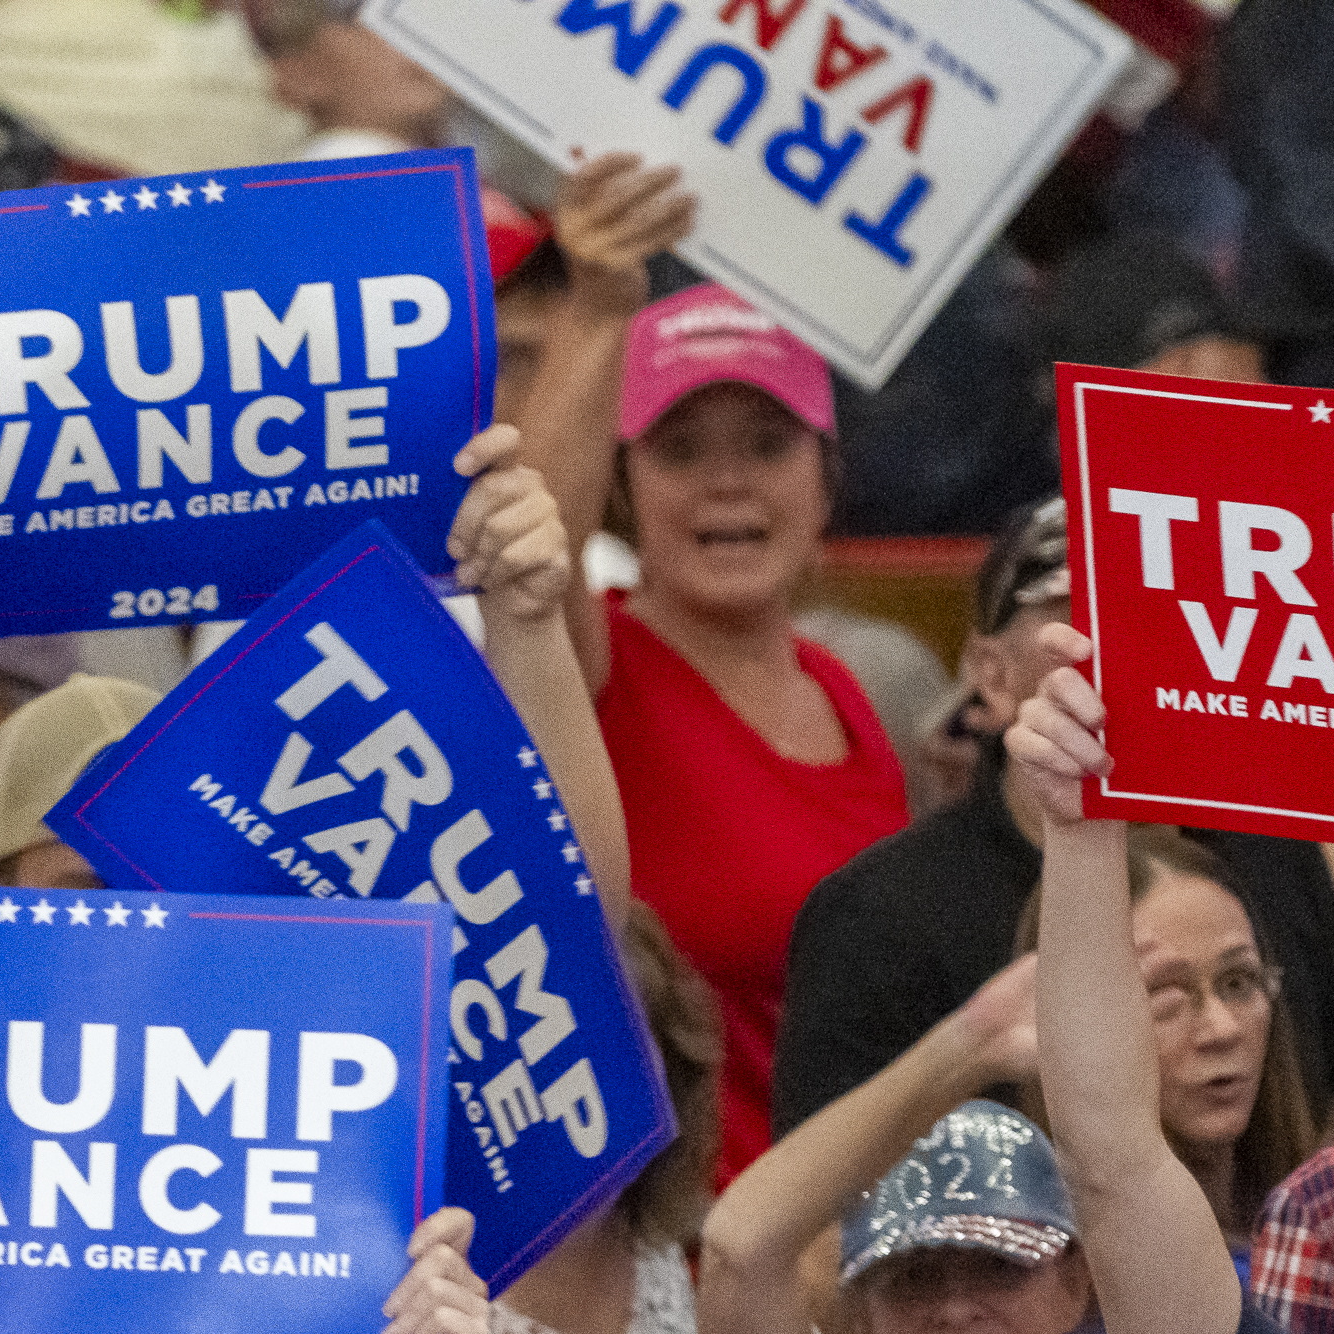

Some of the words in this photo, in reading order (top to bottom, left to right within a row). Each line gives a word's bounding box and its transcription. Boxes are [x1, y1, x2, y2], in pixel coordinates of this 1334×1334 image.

[718, 0, 934, 154] VAN
[555, 0, 933, 268] TRUM
[25, 498, 175, 533] AMERICA
[186, 487, 296, 520] GREAT
[304, 474, 420, 508] AGAIN!
[110, 584, 219, 620] 2024
[1155, 687, 1249, 719] MAKE
[189, 773, 274, 847] MAKE
[274, 621, 608, 1158] TRUMP
[259, 731, 544, 1149] VACE
[454, 1079, 515, 1194] AGAIN!
[84, 1245, 208, 1275] GREAT
[218, 1250, 352, 1279] AGAIN!
